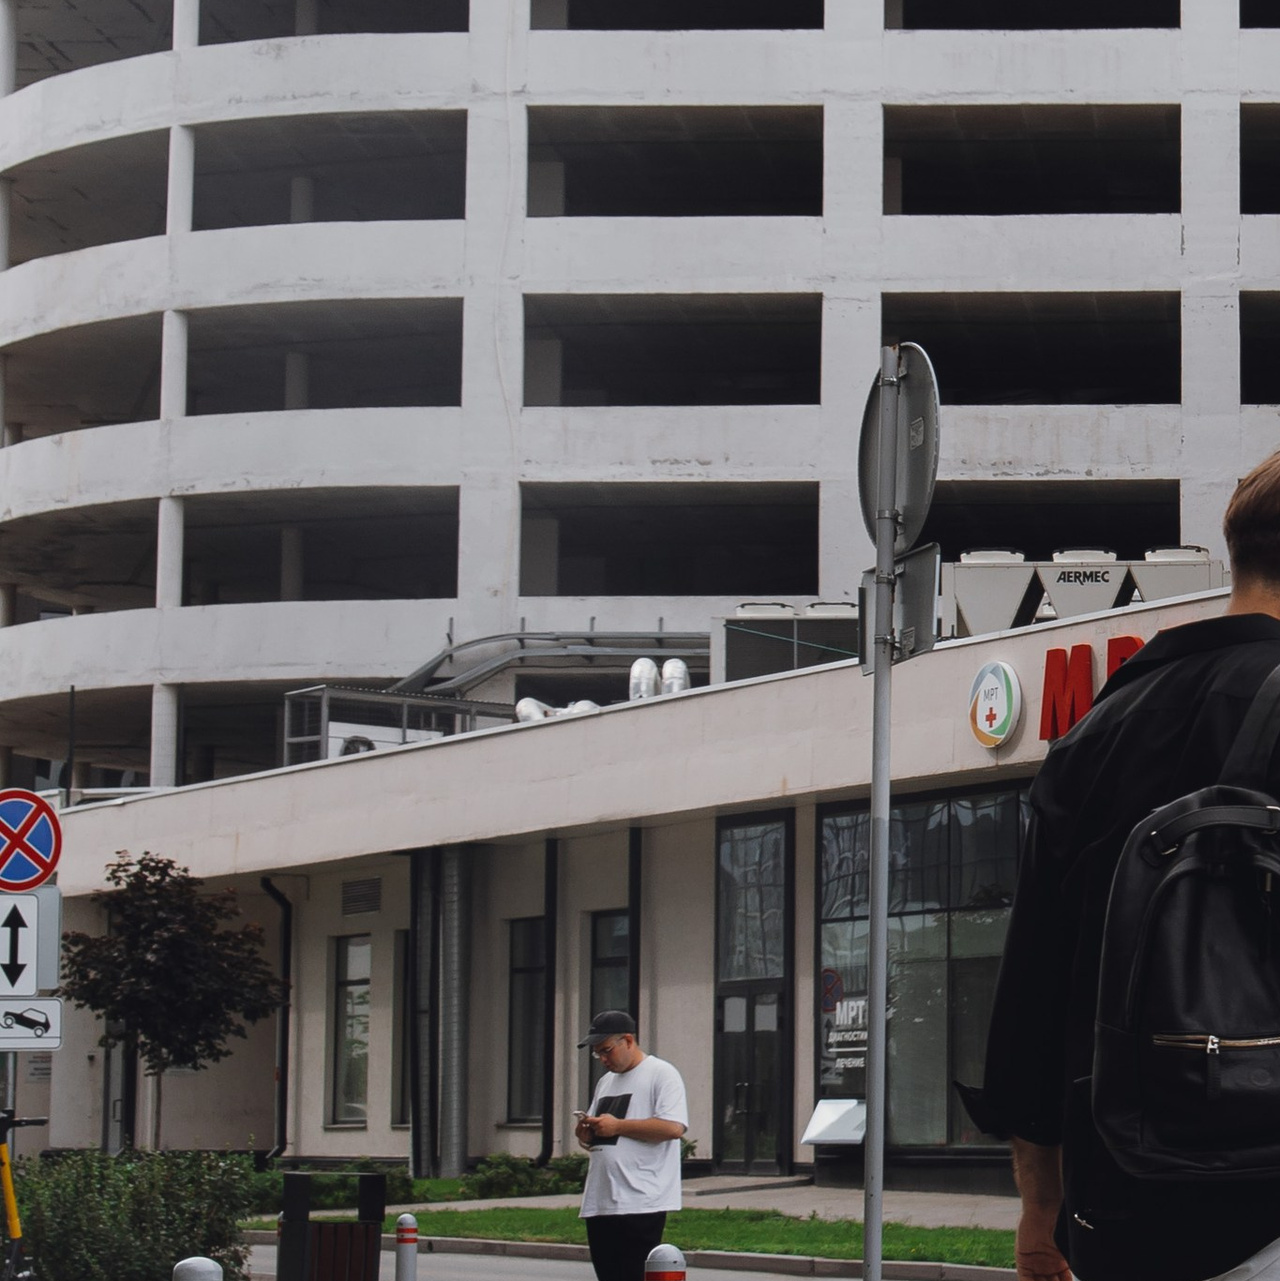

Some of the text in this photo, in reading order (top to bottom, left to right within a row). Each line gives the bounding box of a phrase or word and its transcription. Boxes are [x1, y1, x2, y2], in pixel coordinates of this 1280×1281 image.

[1056, 570, 1110, 586] AERMEC
[983, 687, 999, 702] МРТ
[835, 1000, 866, 1025] МРТ
